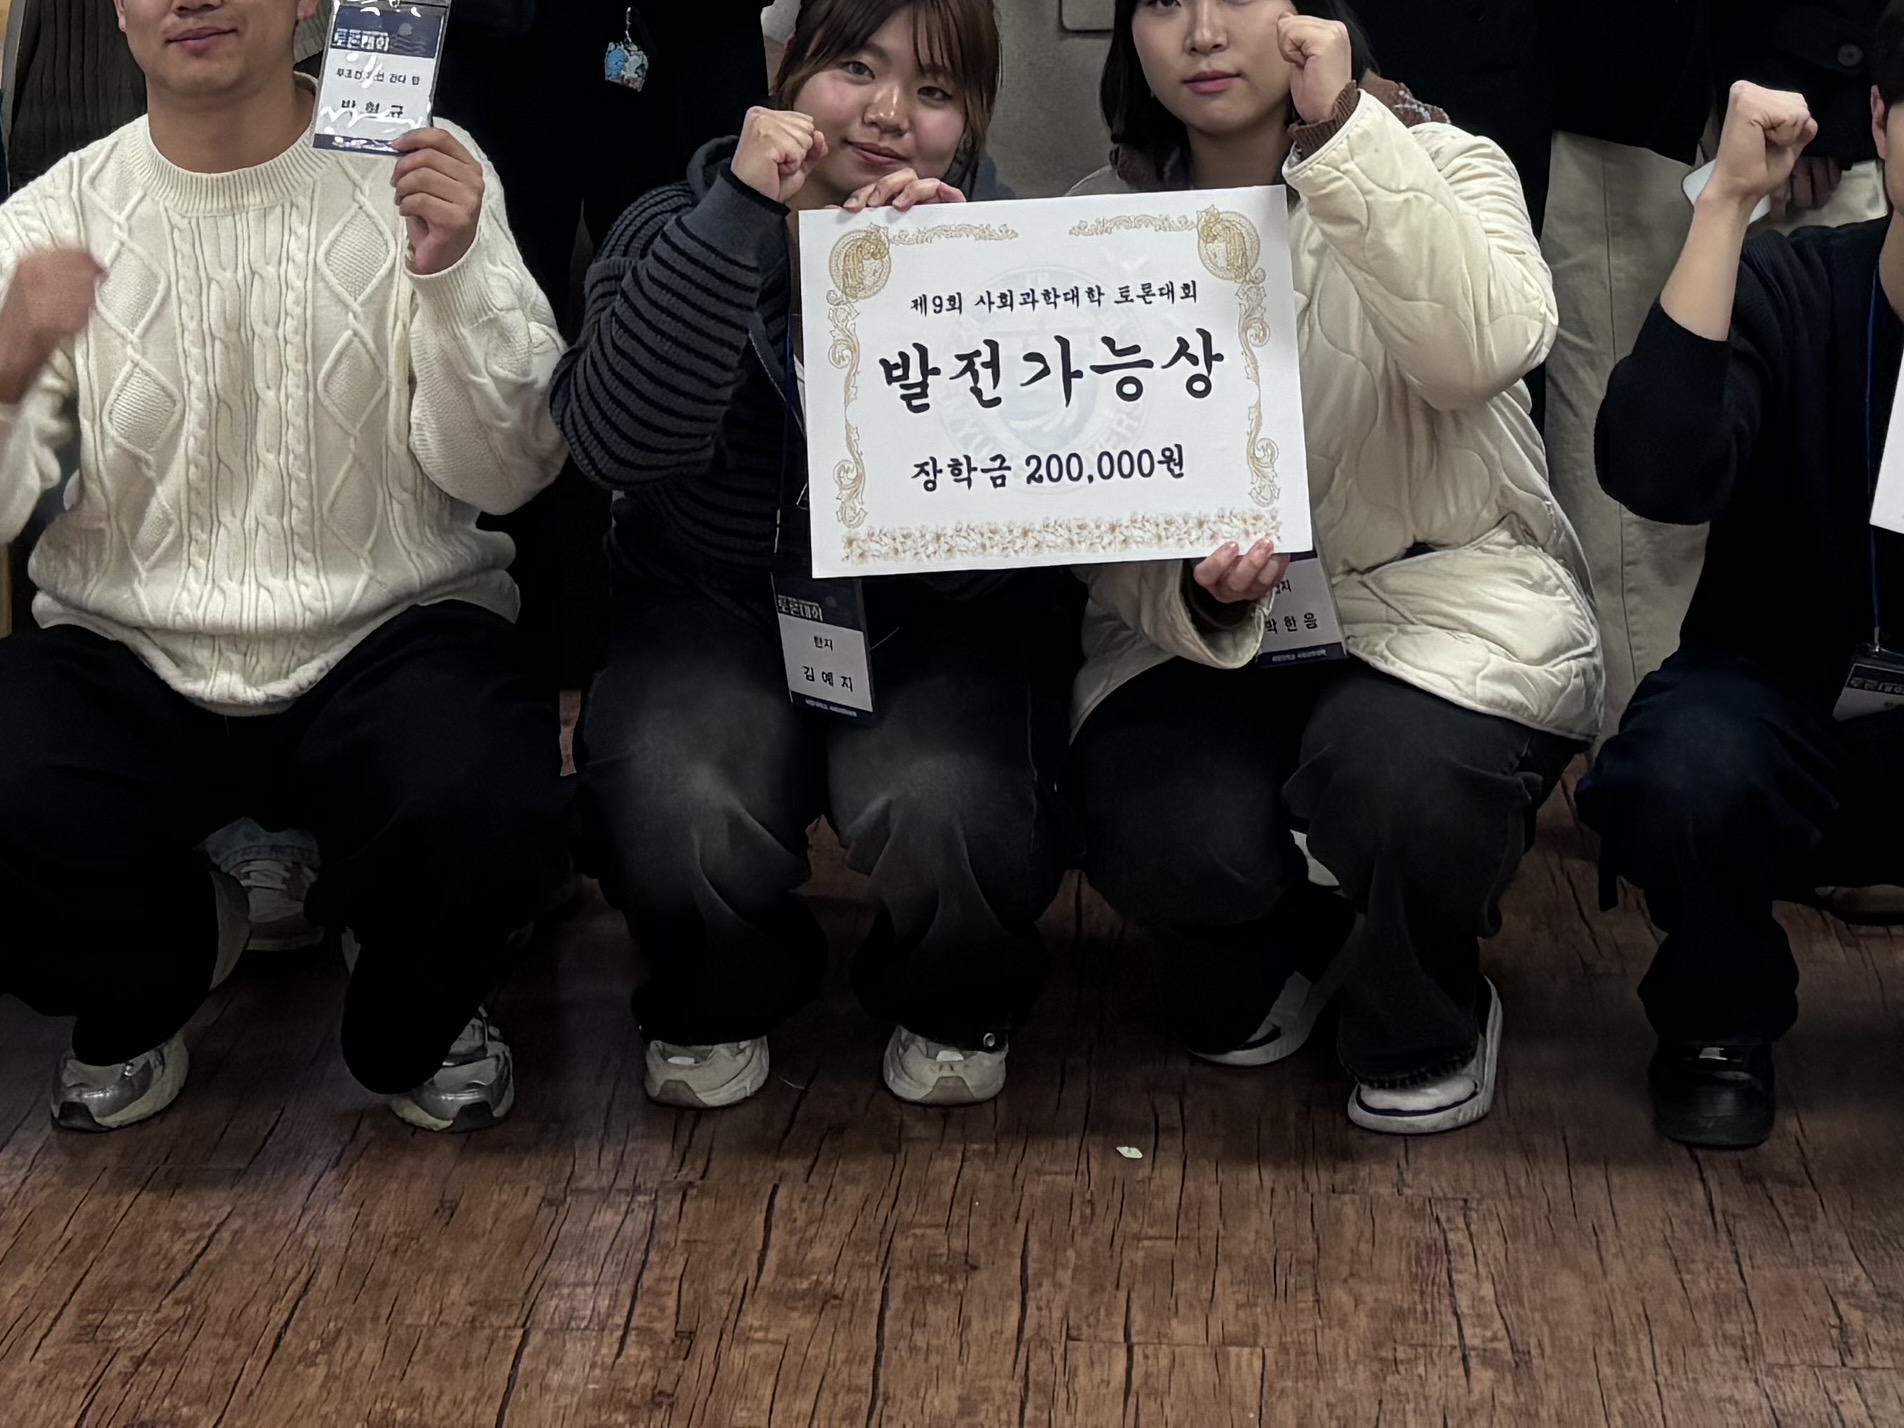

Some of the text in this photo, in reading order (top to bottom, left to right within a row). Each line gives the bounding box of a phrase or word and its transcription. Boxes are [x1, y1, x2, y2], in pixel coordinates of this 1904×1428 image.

[911, 280, 1196, 316] 제9회 사회과학대학 토론대회
[879, 328, 1224, 413] 발전가능상
[912, 444, 1184, 492] 장학금 200,000원
